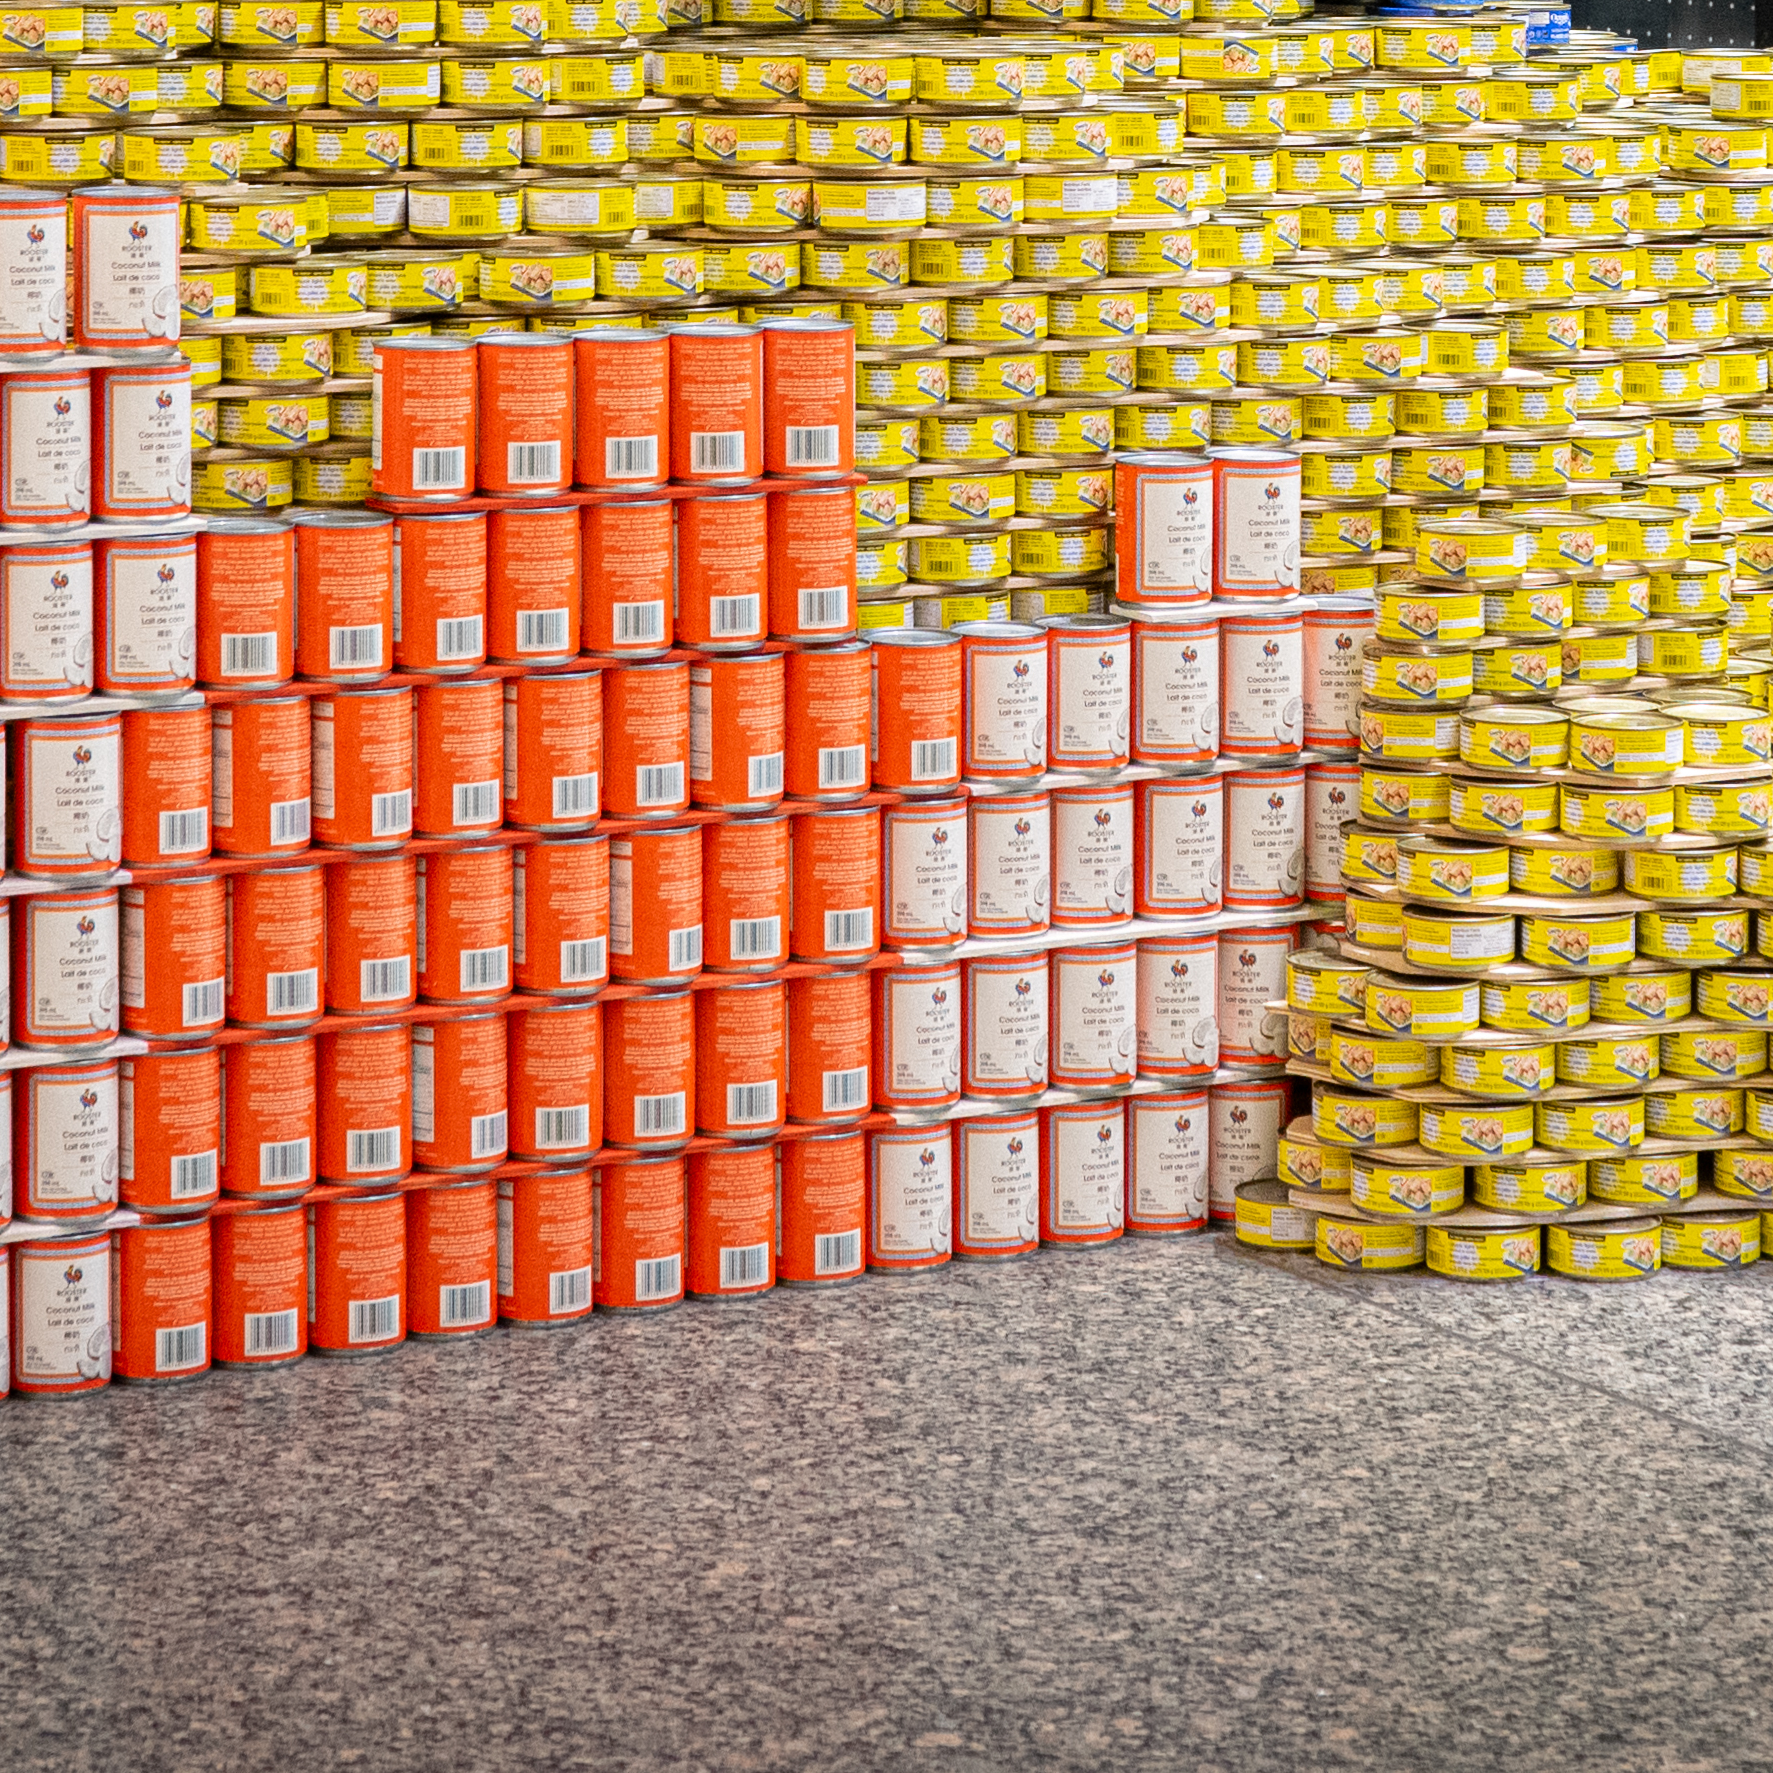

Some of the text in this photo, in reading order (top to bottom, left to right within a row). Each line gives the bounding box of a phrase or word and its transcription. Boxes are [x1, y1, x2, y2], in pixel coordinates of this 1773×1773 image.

[111, 261, 145, 270] Coconut
[11, 278, 25, 286] Lait
[113, 274, 127, 282] Lait
[1249, 530, 1263, 538] Lait
[1155, 996, 1187, 1004] Coconut
[1156, 1007, 1169, 1015] Lait
[1170, 1007, 1180, 1015] de
